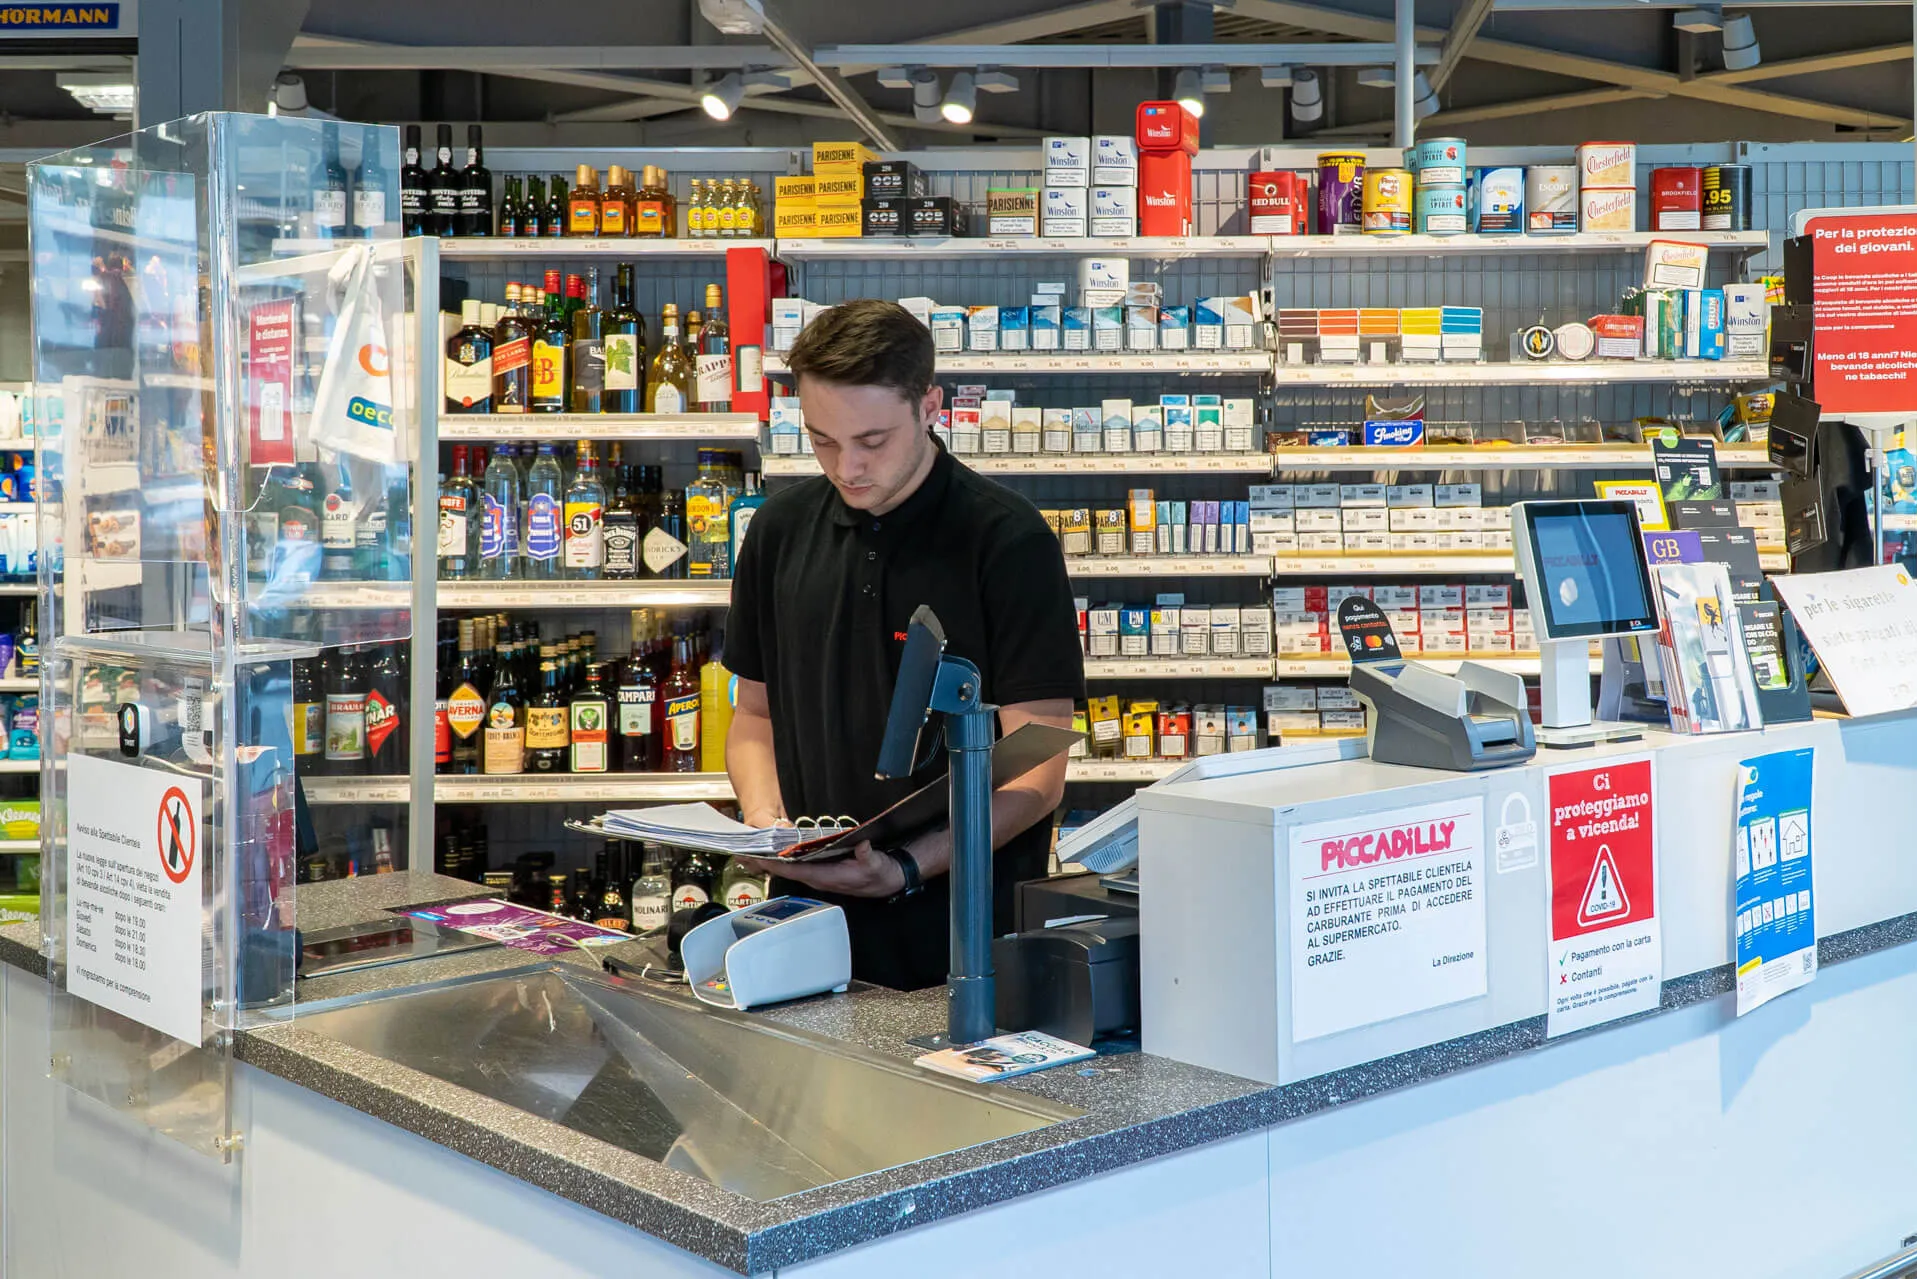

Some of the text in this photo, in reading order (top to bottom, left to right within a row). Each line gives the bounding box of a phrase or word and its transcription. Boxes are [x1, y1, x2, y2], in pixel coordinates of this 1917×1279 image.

[1147, 127, 1171, 137] Winston
[816, 149, 855, 161] PARISIENNE
[1050, 154, 1079, 166] Winston
[1098, 153, 1128, 165] Winston
[1587, 149, 1630, 175] Chesterfield
[818, 180, 857, 193] PARISIENNE
[872, 176, 902, 186] OCB
[1146, 194, 1176, 206] Winston
[1272, 198, 1290, 206] BULL
[1704, 189, 1731, 204] .95
[988, 197, 1035, 211] PARISIENNE
[1047, 205, 1077, 216] Winston
[1095, 204, 1125, 216] Winston
[1587, 193, 1631, 219] Chesterfield
[778, 213, 816, 225] PARISIENNE
[820, 211, 859, 225] PARISIENNE
[868, 212, 899, 222] OCB
[913, 211, 944, 221] OCB
[1816, 229, 1839, 239] Per
[1841, 228, 1854, 238] la
[1835, 241, 1915, 255] dei giovani.
[1089, 277, 1119, 288] Winston
[1728, 316, 1761, 327] Winston
[1817, 351, 1898, 361] Meno di 18 anni?
[1831, 361, 1874, 371] bevande
[1859, 370, 1907, 380] tabacchi!
[572, 518, 588, 531] 51
[1652, 538, 1680, 558] GB
[1803, 602, 1822, 620] per
[1824, 598, 1838, 612] le
[894, 631, 908, 640] Pic
[618, 690, 656, 703] CAMPARI
[449, 703, 483, 716] AVERNA
[668, 700, 699, 715] APERO
[1593, 773, 1611, 790] Ci
[1554, 792, 1648, 826] proteggiamo
[1566, 811, 1639, 840] a vicenda!
[1306, 860, 1472, 902] SI INVITA LA SPETTABILE CLIENTELA
[1307, 875, 1472, 918] AD EFFETTUARE IL PAGAMENTO DEL
[634, 905, 669, 915] MOLINARI
[1307, 889, 1472, 933] CARBURANTE PRIMA DI ACCEDERE
[1590, 901, 1616, 913] COVID-19
[1307, 920, 1402, 949] AL SUPERMERCATO.
[1571, 935, 1652, 962] Pagamento con la carta
[1308, 950, 1346, 967] GRAZIE.
[1432, 951, 1474, 967] La Direzione
[1571, 967, 1603, 982] Contanti
